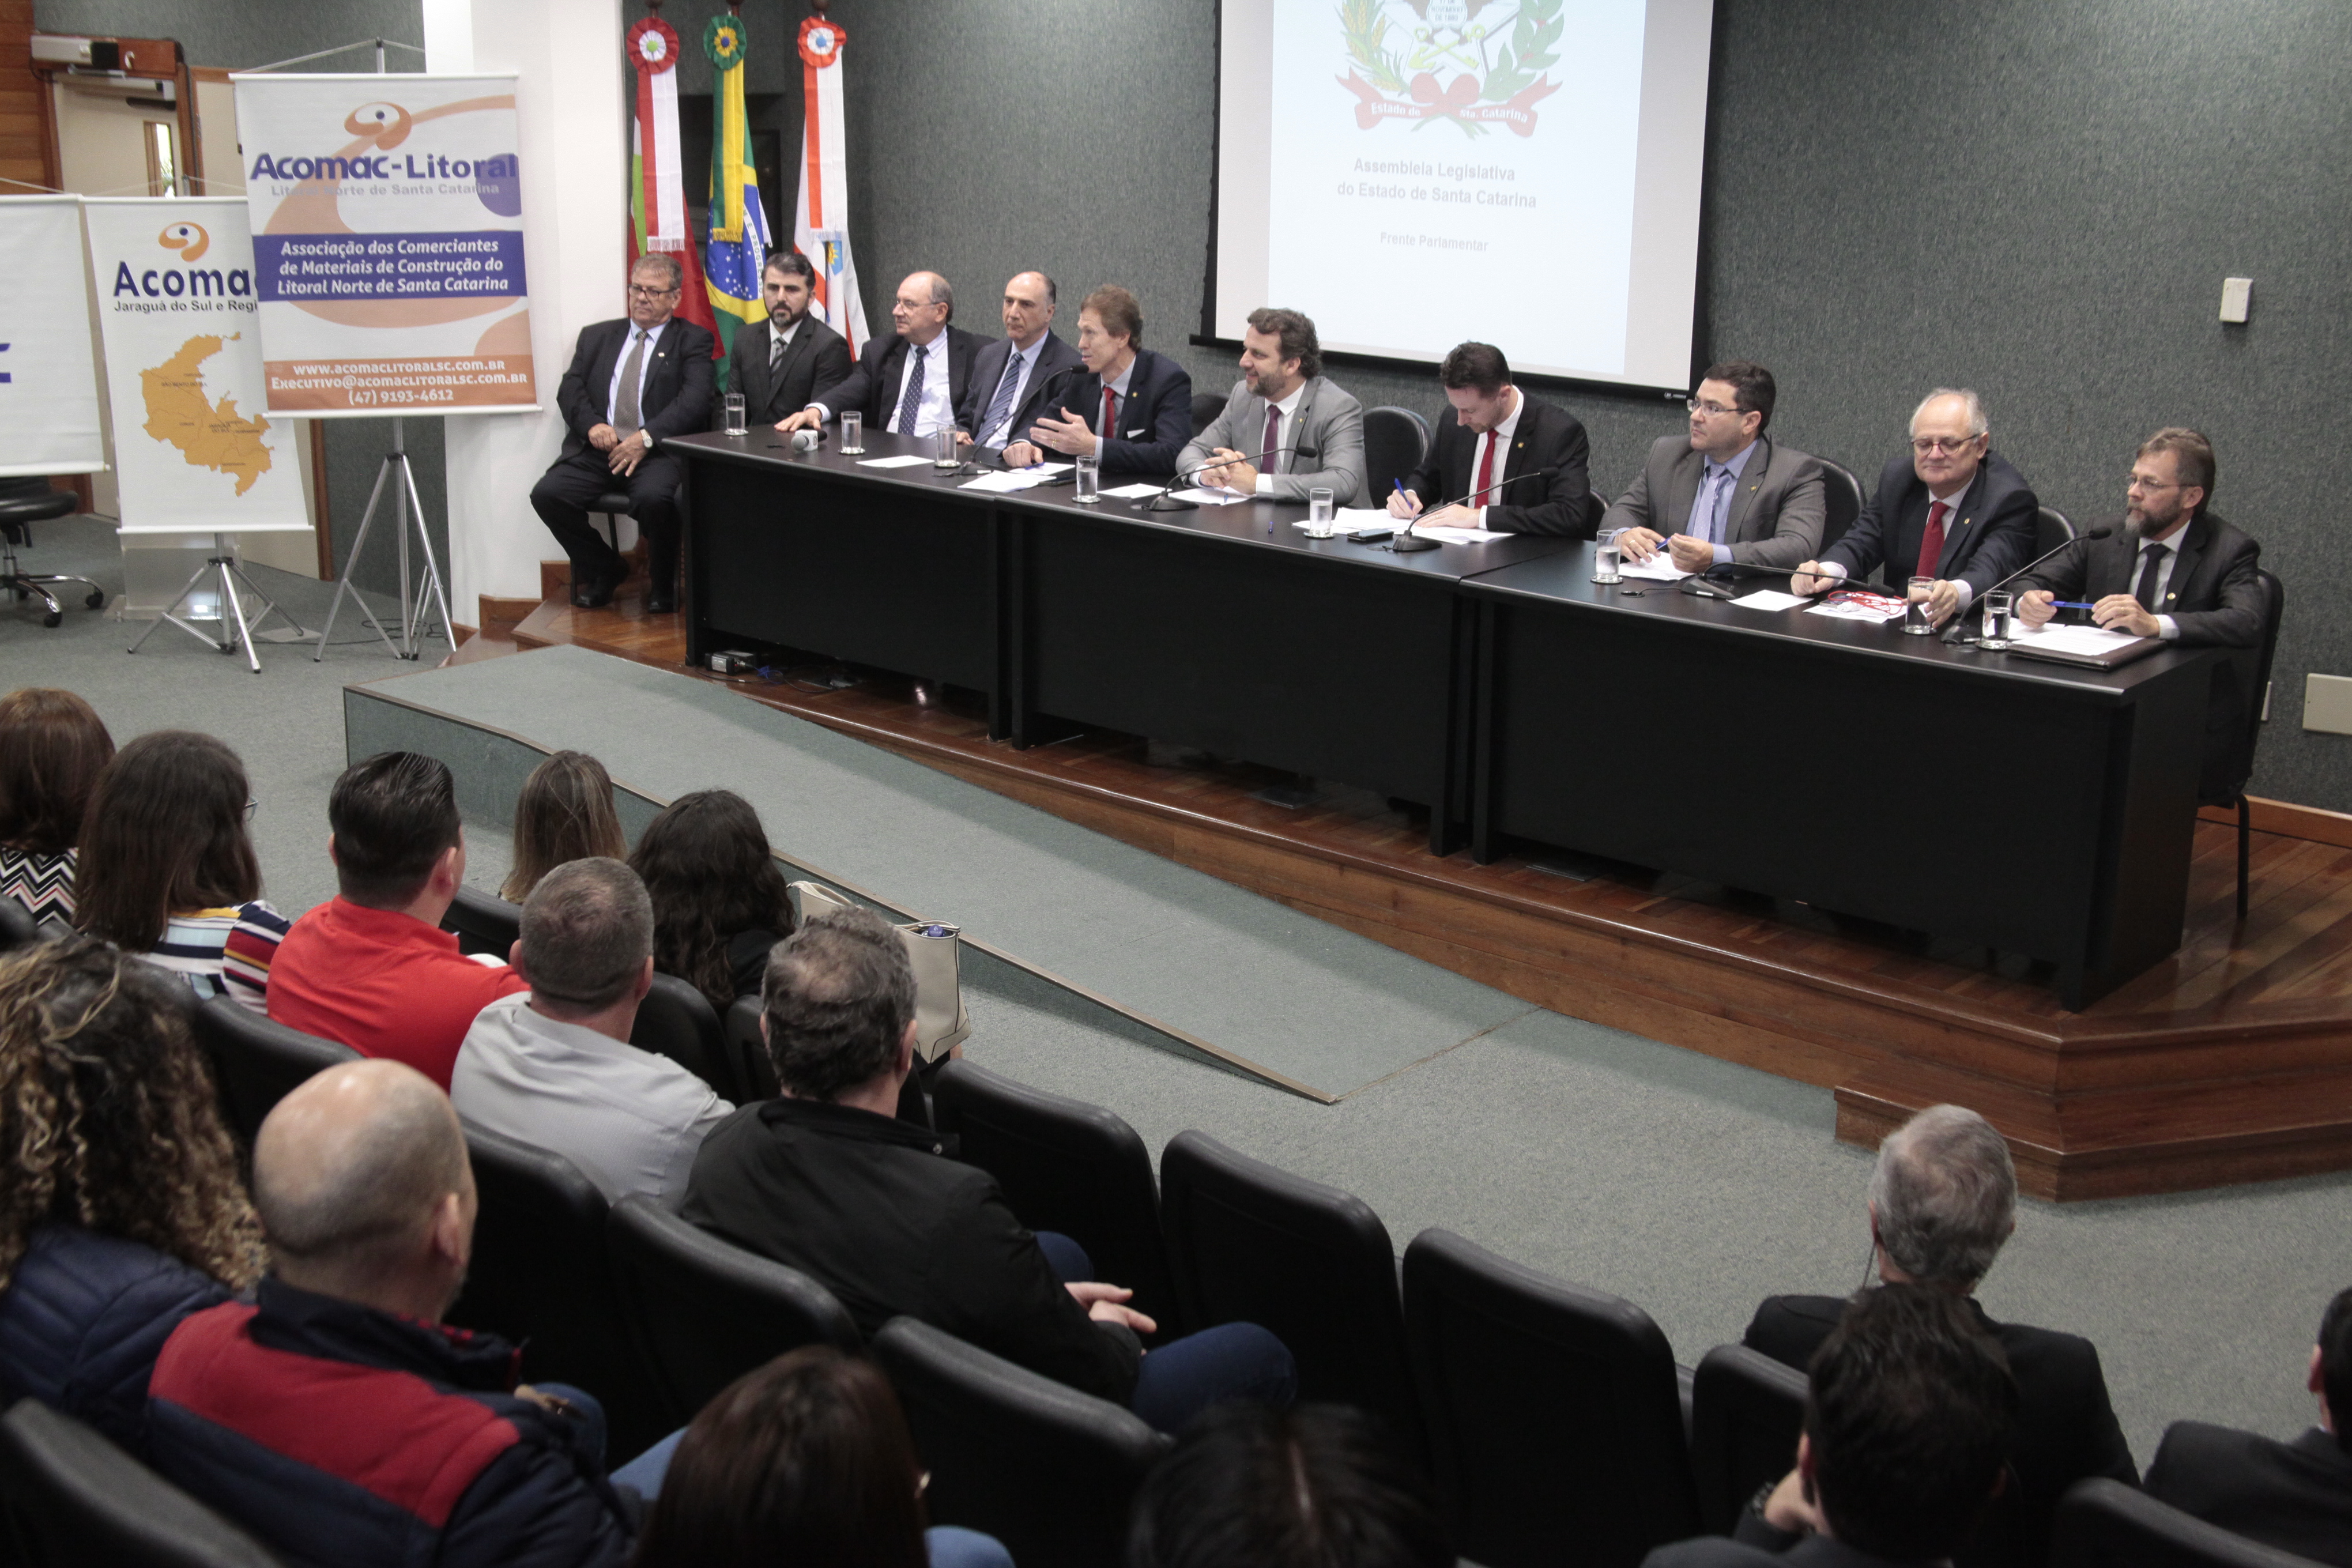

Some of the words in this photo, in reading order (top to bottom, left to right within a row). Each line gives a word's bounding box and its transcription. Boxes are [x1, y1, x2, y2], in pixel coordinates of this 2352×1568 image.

[1371, 102, 1405, 115] Estado
[1408, 107, 1420, 116] de
[1482, 108, 1528, 123] Catarina
[250, 153, 516, 180] Acomac-Litoral
[1354, 158, 1433, 176] Assembleia
[1438, 163, 1515, 182] Legislativa
[272, 185, 318, 197] Litoral
[323, 184, 364, 196] Norte
[370, 184, 386, 195] de
[392, 184, 433, 195] Santa
[438, 183, 499, 194] Catarina
[1337, 182, 1354, 195] do
[1359, 182, 1406, 199] Estado
[1411, 186, 1427, 201] de
[1432, 187, 1471, 203] Santa
[1476, 190, 1536, 208] Catarina
[281, 240, 365, 258] Associação
[368, 240, 394, 255] dos
[398, 238, 498, 254] Comerciantes
[1380, 232, 1416, 246] Frente
[1419, 235, 1488, 252] Parlamentar
[280, 261, 297, 275] de
[301, 259, 373, 274] Materiais
[376, 259, 394, 274] de
[398, 258, 481, 276] Construção
[484, 257, 503, 272] do
[114, 261, 258, 296] Acoma
[278, 280, 327, 295] Litoral
[331, 279, 372, 294] Norte
[376, 278, 394, 293] de
[397, 278, 440, 292] Santa
[444, 276, 508, 291] Catarina
[114, 300, 166, 314] Jaraguá
[170, 300, 187, 311] do
[191, 300, 212, 311] Sul
[216, 303, 224, 311] e
[228, 300, 258, 312] Regi
[349, 389, 378, 405] (47)
[380, 389, 454, 403] 9193-4612
